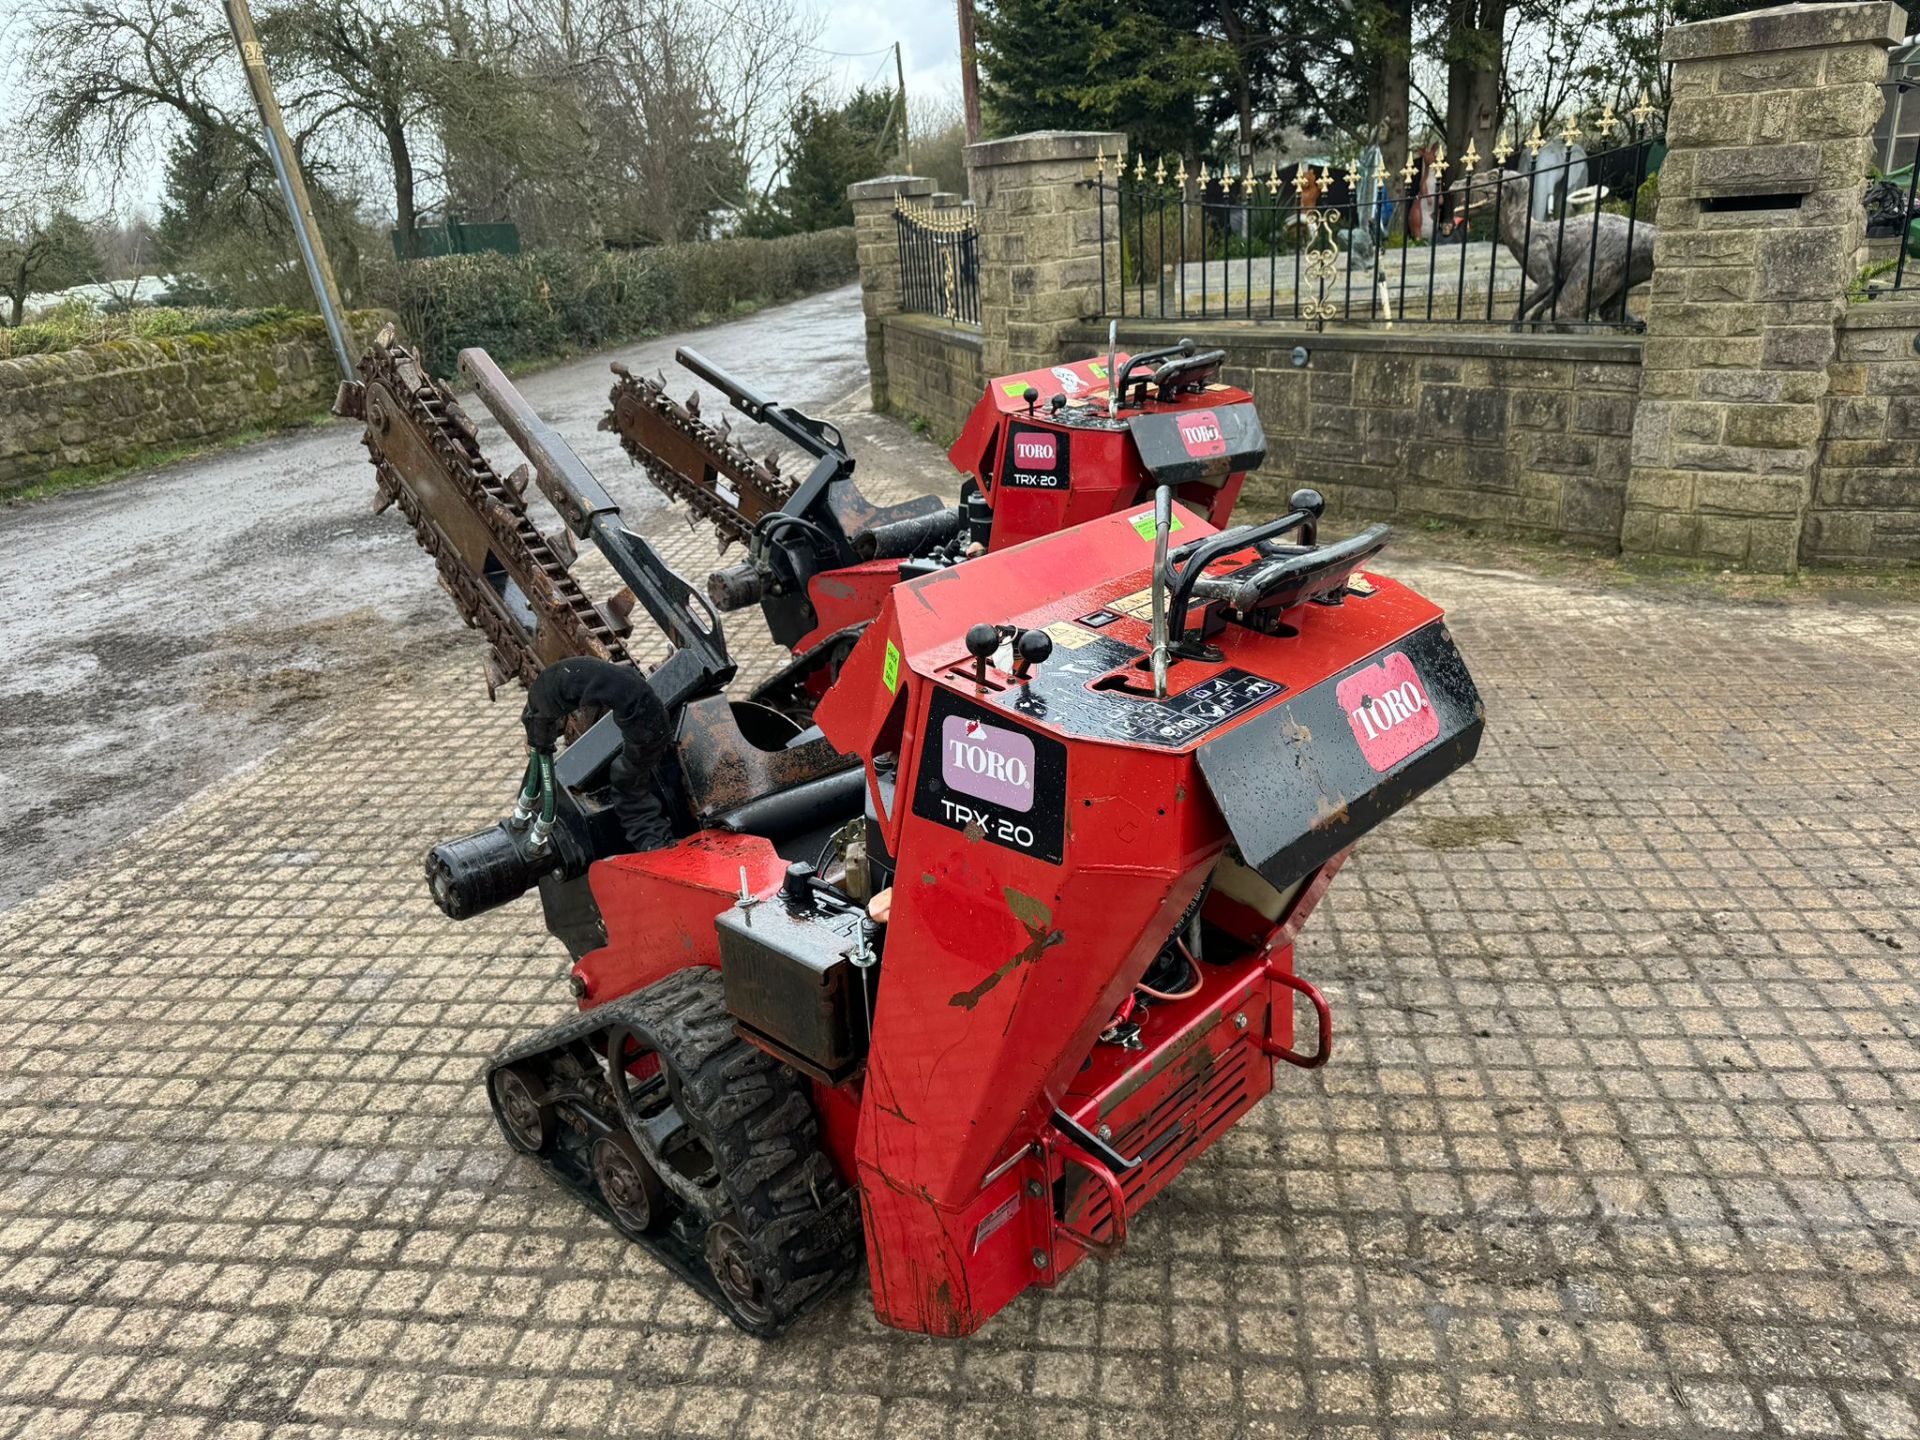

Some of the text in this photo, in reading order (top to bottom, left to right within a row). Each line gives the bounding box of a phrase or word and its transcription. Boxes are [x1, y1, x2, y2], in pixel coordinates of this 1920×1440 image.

[1017, 444, 1053, 458] TORO
[1352, 681, 1421, 741] TORO
[950, 739, 1027, 786] TORO
